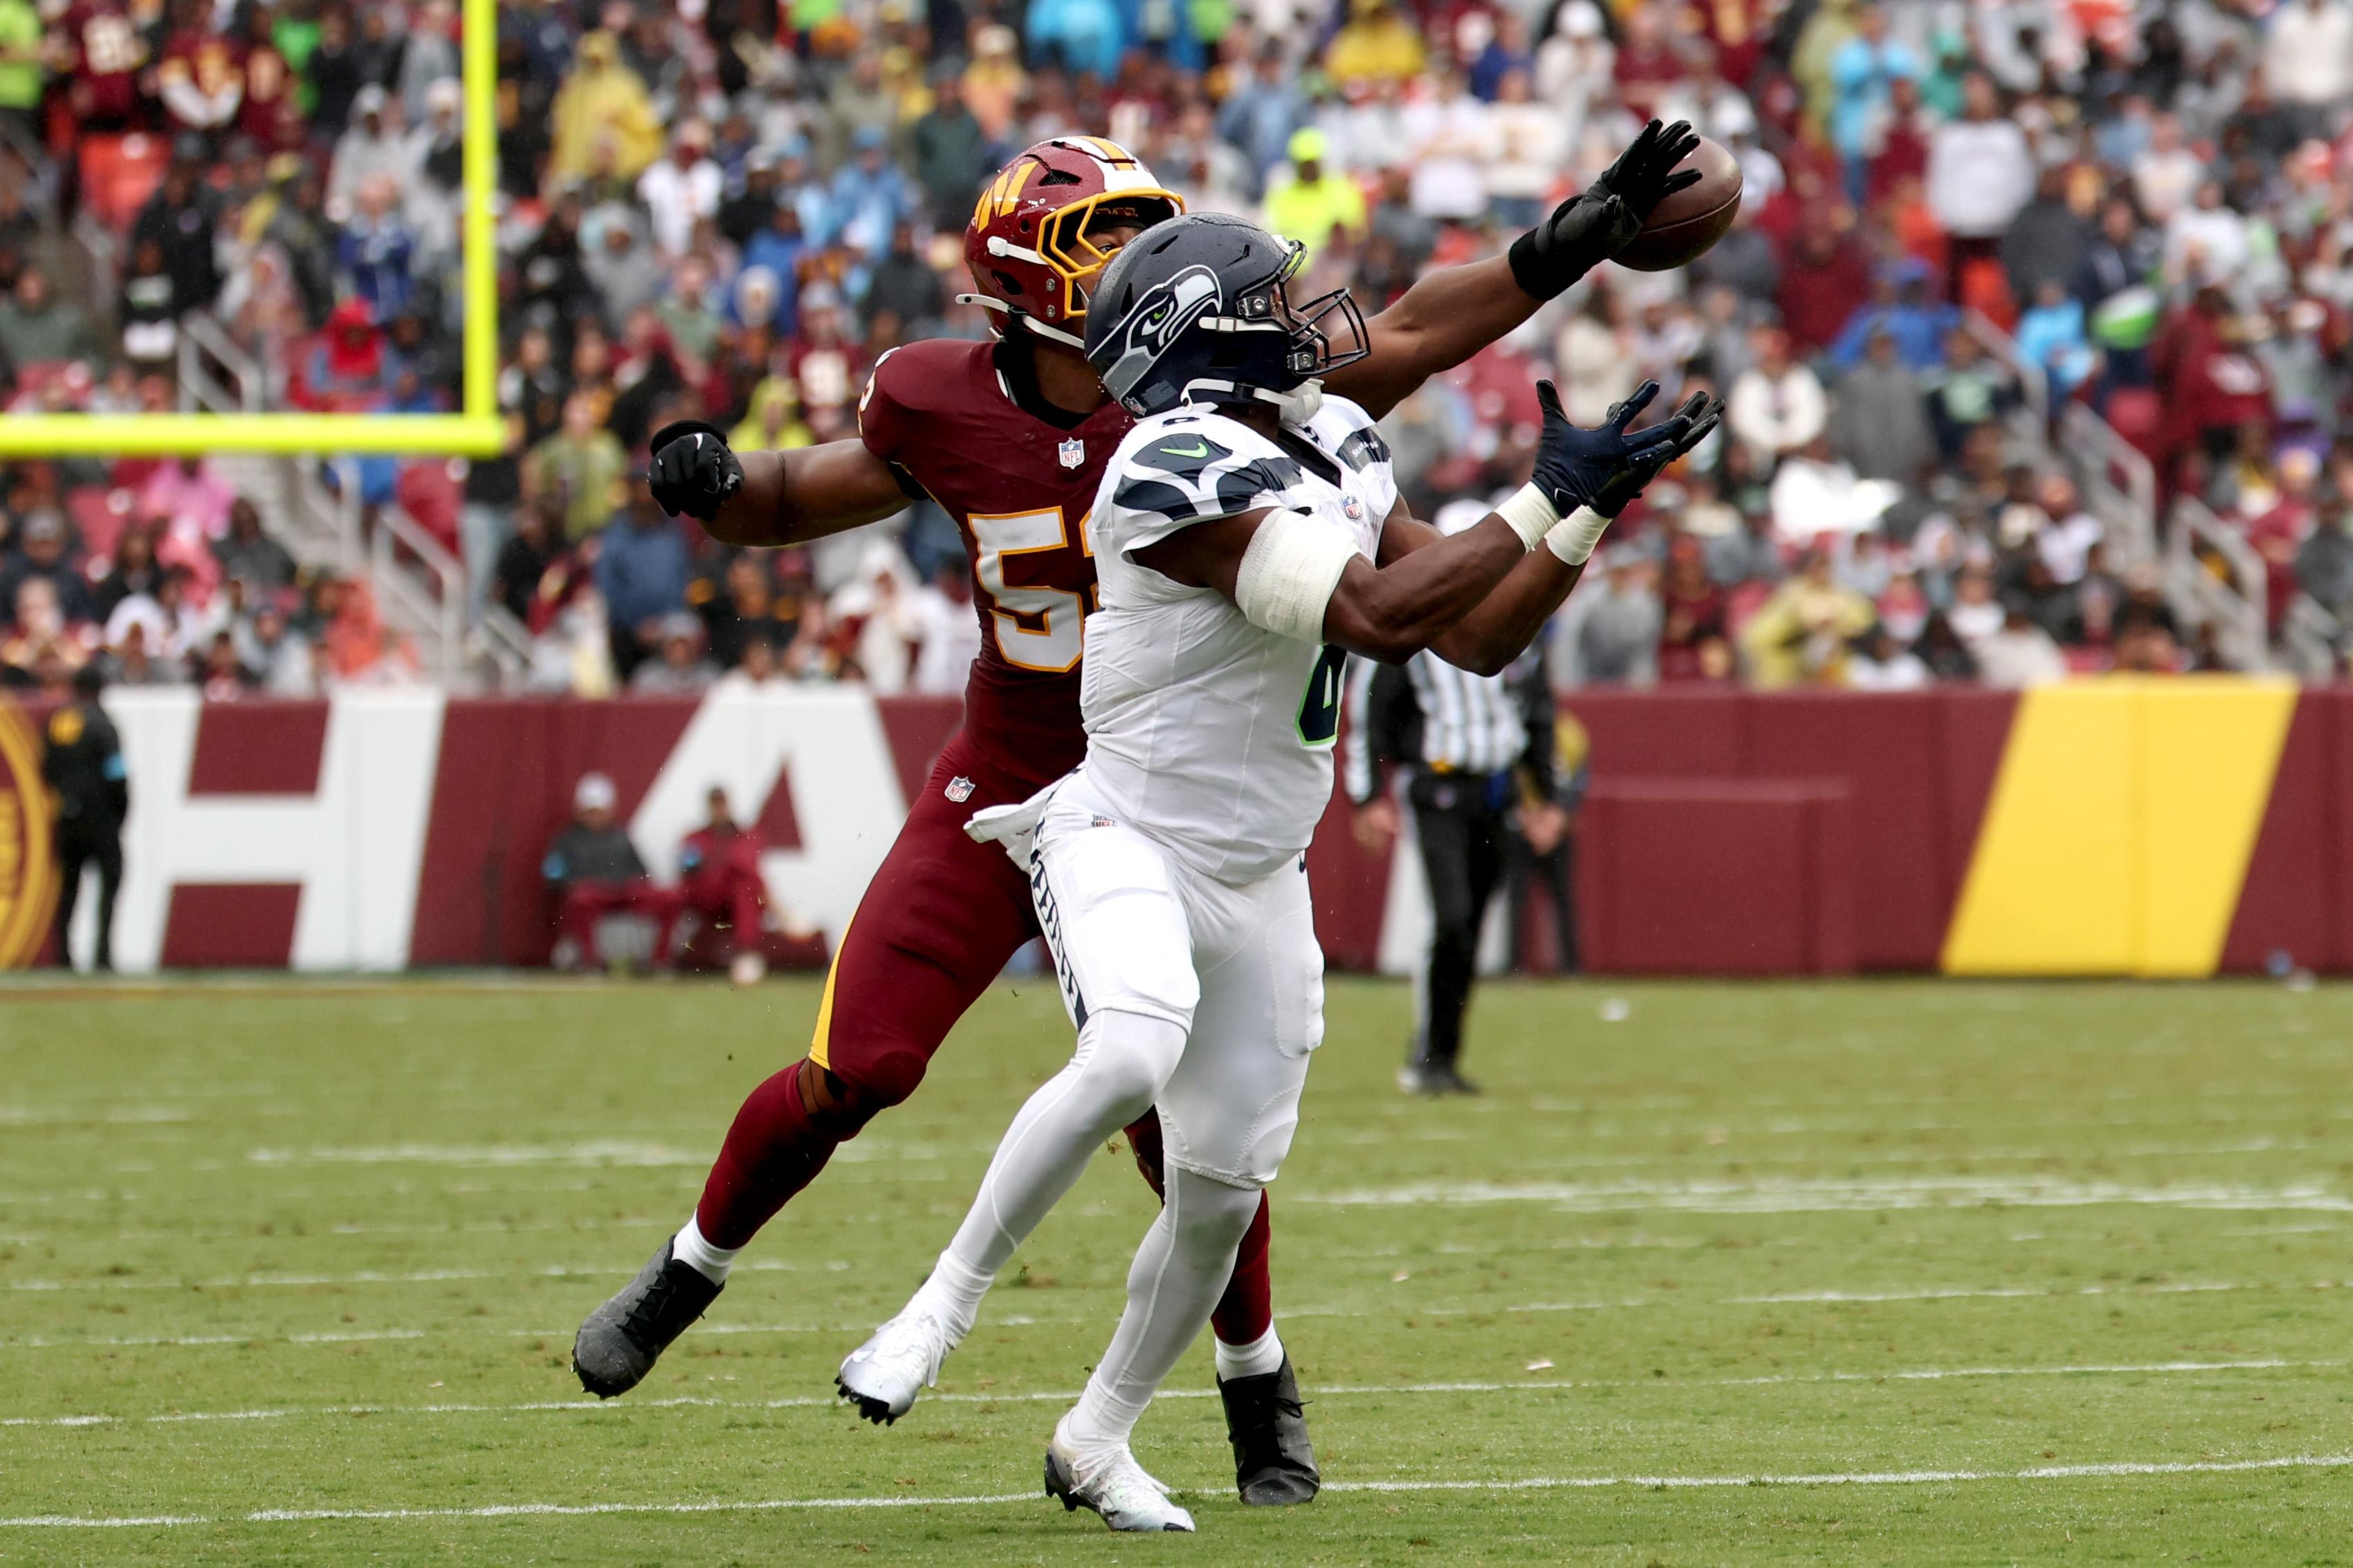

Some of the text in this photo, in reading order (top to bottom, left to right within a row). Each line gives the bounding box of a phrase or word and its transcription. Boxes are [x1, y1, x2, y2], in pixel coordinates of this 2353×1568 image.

[1063, 452, 1081, 463] NFL
[967, 505, 1101, 673] 5
[949, 786, 967, 799] NFL
